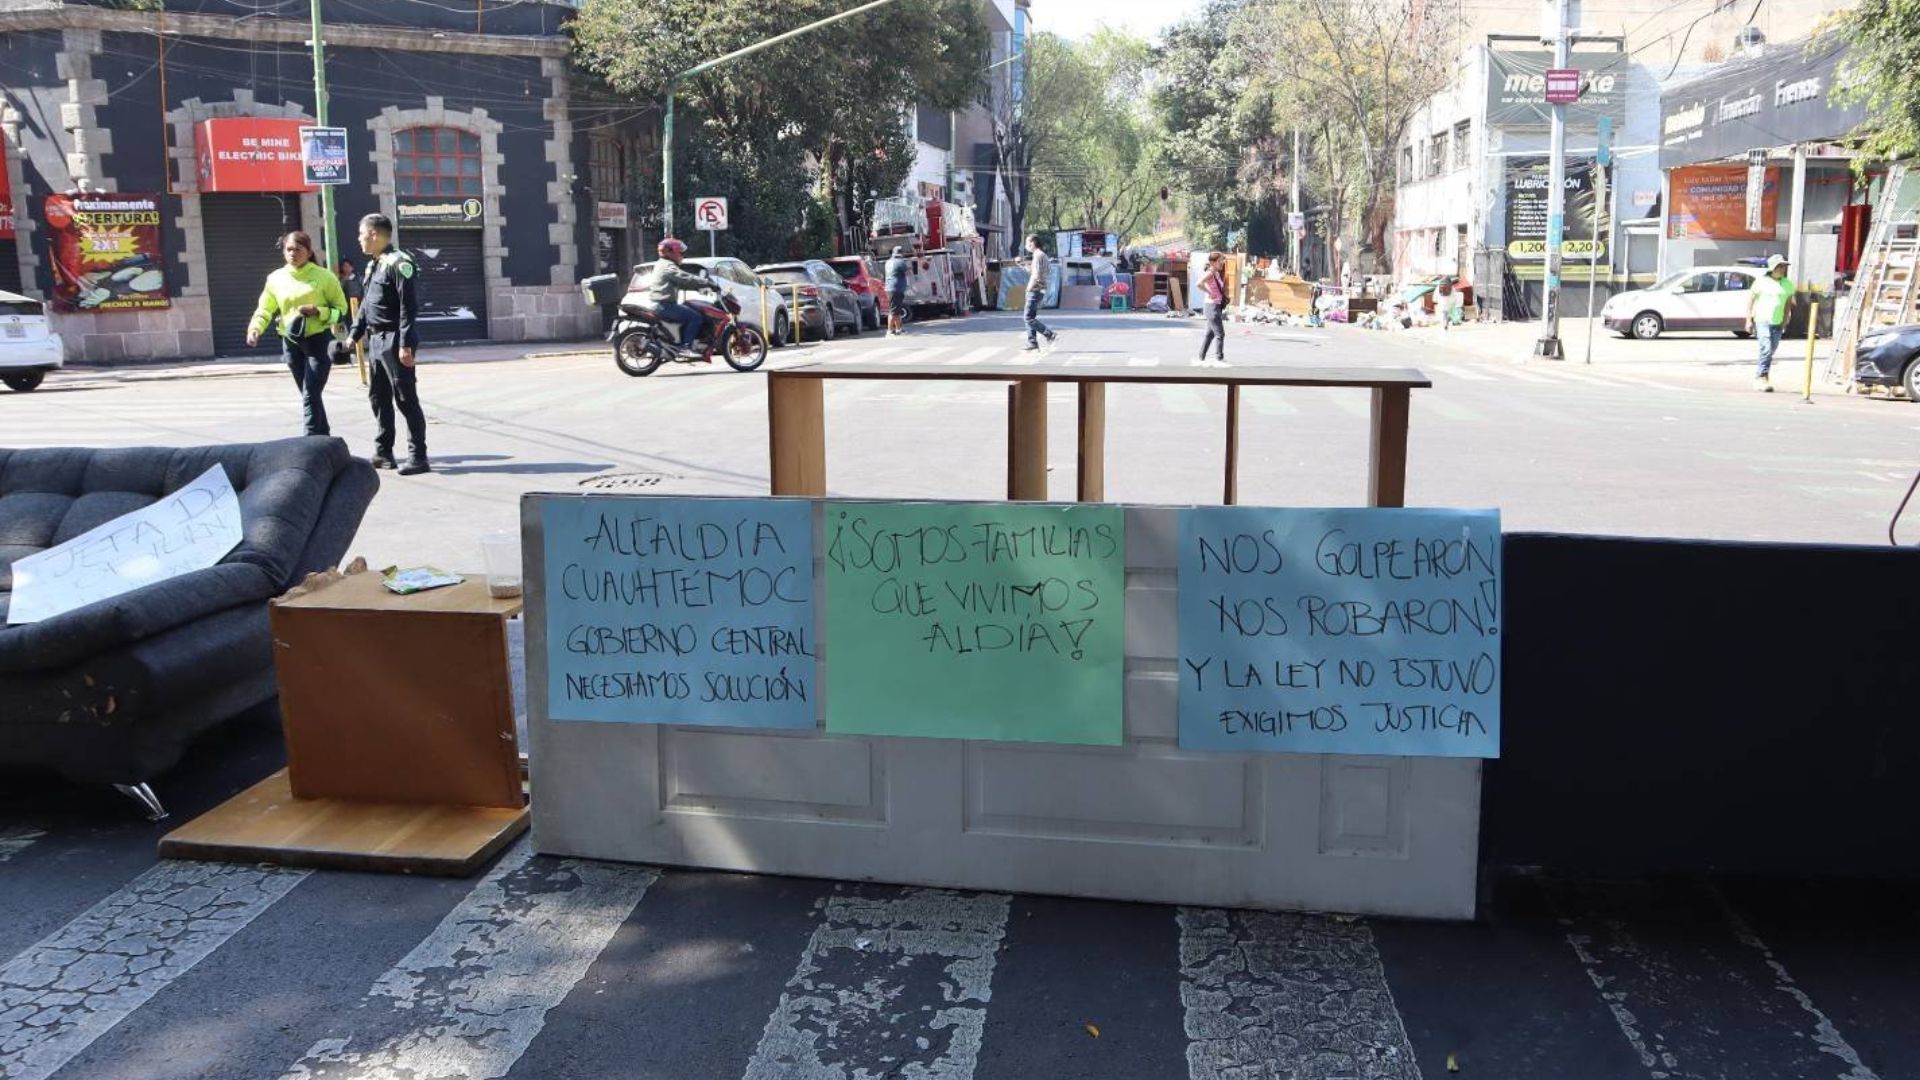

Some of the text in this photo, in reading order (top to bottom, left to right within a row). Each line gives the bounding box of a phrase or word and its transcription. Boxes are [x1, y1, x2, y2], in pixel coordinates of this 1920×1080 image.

[1775, 77, 1820, 106] Frenos
[218, 151, 273, 160] ELECTRIC
[242, 138, 290, 147] BE MINE
[1514, 177, 1581, 189] LUBRICÓN
[1199, 528, 1496, 580] NOS GOLPEARON
[562, 563, 808, 608] CUAUHTÉMOC
[871, 576, 1099, 617] QUE VIVIMOS
[566, 623, 819, 658] GOBIERNO CENTRAL
[700, 666, 807, 702] SOLUCIÓN
[1185, 651, 1496, 695] Y LA LEY NO ESTUVO
[1219, 704, 1348, 736] EXIGIMOS
